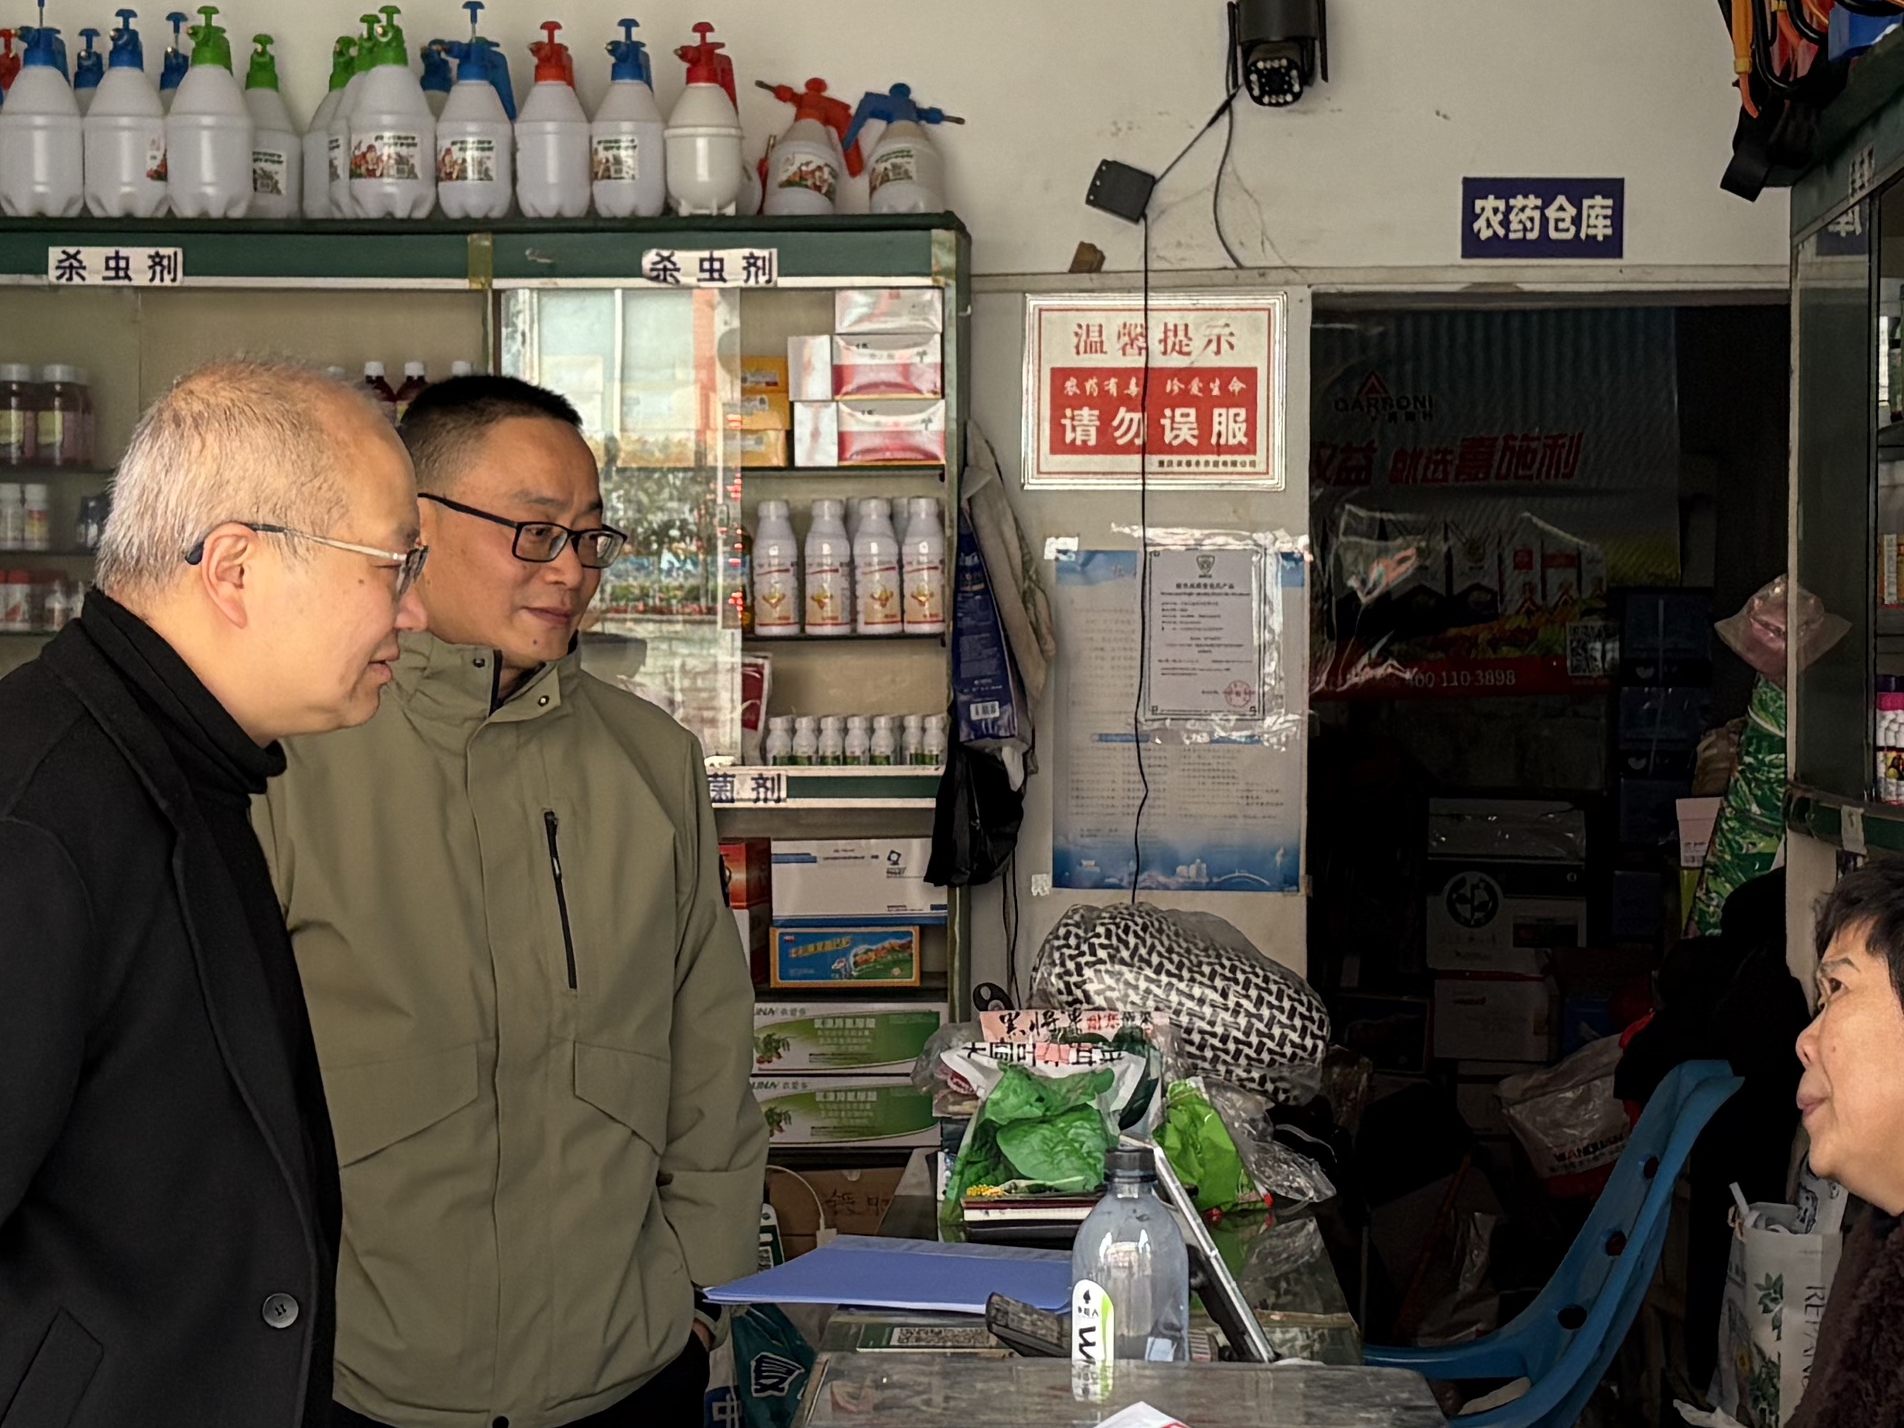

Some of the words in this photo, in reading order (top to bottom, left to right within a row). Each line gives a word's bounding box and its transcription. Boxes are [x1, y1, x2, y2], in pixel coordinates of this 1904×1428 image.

[1473, 195, 1614, 241] 农药仓库
[55, 250, 178, 284] 杀虫剂
[649, 250, 774, 285] 杀虫剂
[1072, 322, 1236, 357] 温馨提示
[1063, 377, 1140, 399] 农药有毒
[1165, 376, 1247, 398] 珍爱生命
[1061, 405, 1249, 447] 请勿误服
